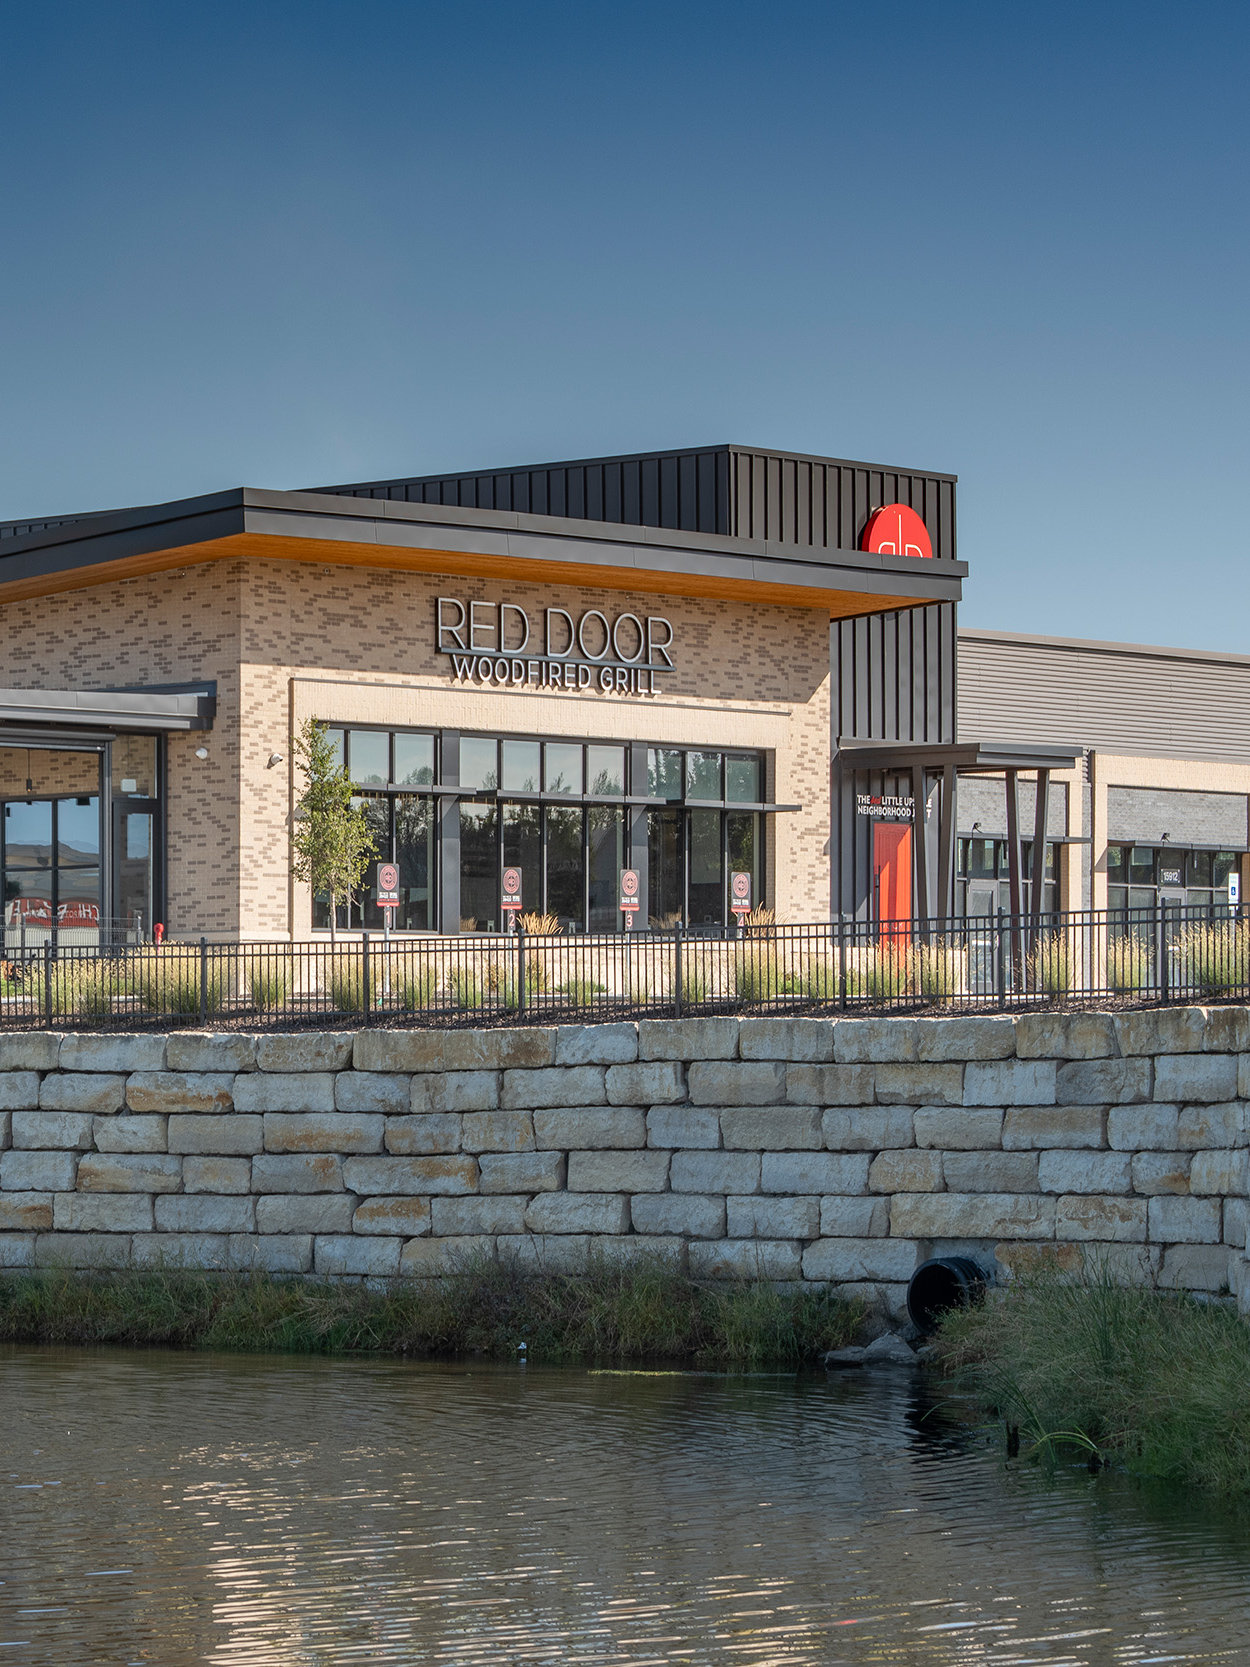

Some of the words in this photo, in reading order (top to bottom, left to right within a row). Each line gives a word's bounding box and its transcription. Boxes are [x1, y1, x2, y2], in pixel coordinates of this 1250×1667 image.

[436, 597, 530, 655] RED
[546, 607, 675, 667] DOOR
[452, 654, 591, 689] WOODFIRED
[600, 667, 662, 695] GRILL
[857, 795, 870, 804] THE
[882, 796, 903, 806] LITTLE
[857, 805, 912, 817] NEIGHBORHOOD
[385, 911, 390, 924] 1
[509, 913, 515, 927] 2
[626, 914, 633, 928] 3
[738, 916, 745, 927] 4
